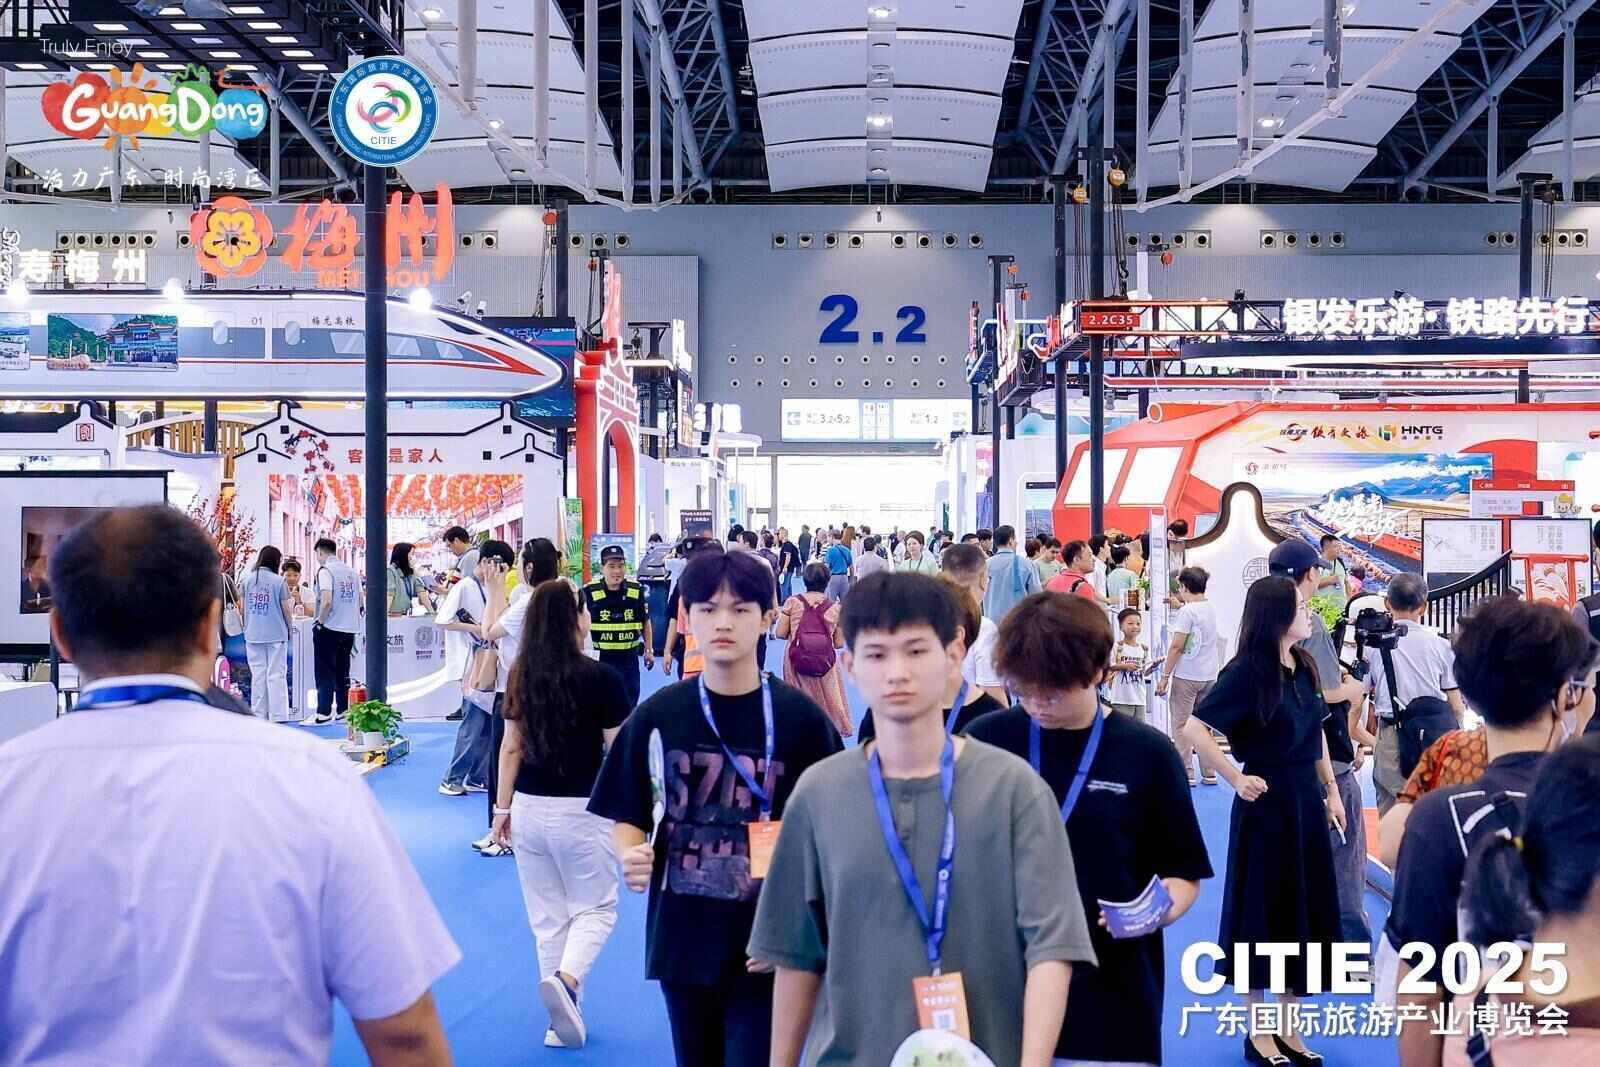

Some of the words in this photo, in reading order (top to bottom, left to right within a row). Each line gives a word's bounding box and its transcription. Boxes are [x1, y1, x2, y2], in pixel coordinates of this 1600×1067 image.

[251, 317, 263, 326] 01
[818, 294, 927, 344] 2.2
[1088, 314, 1134, 326] 2.2C35
[1401, 425, 1443, 435] HNTG
[348, 448, 443, 464] 客是家人
[600, 632, 613, 641] AN
[618, 632, 634, 641] BAO
